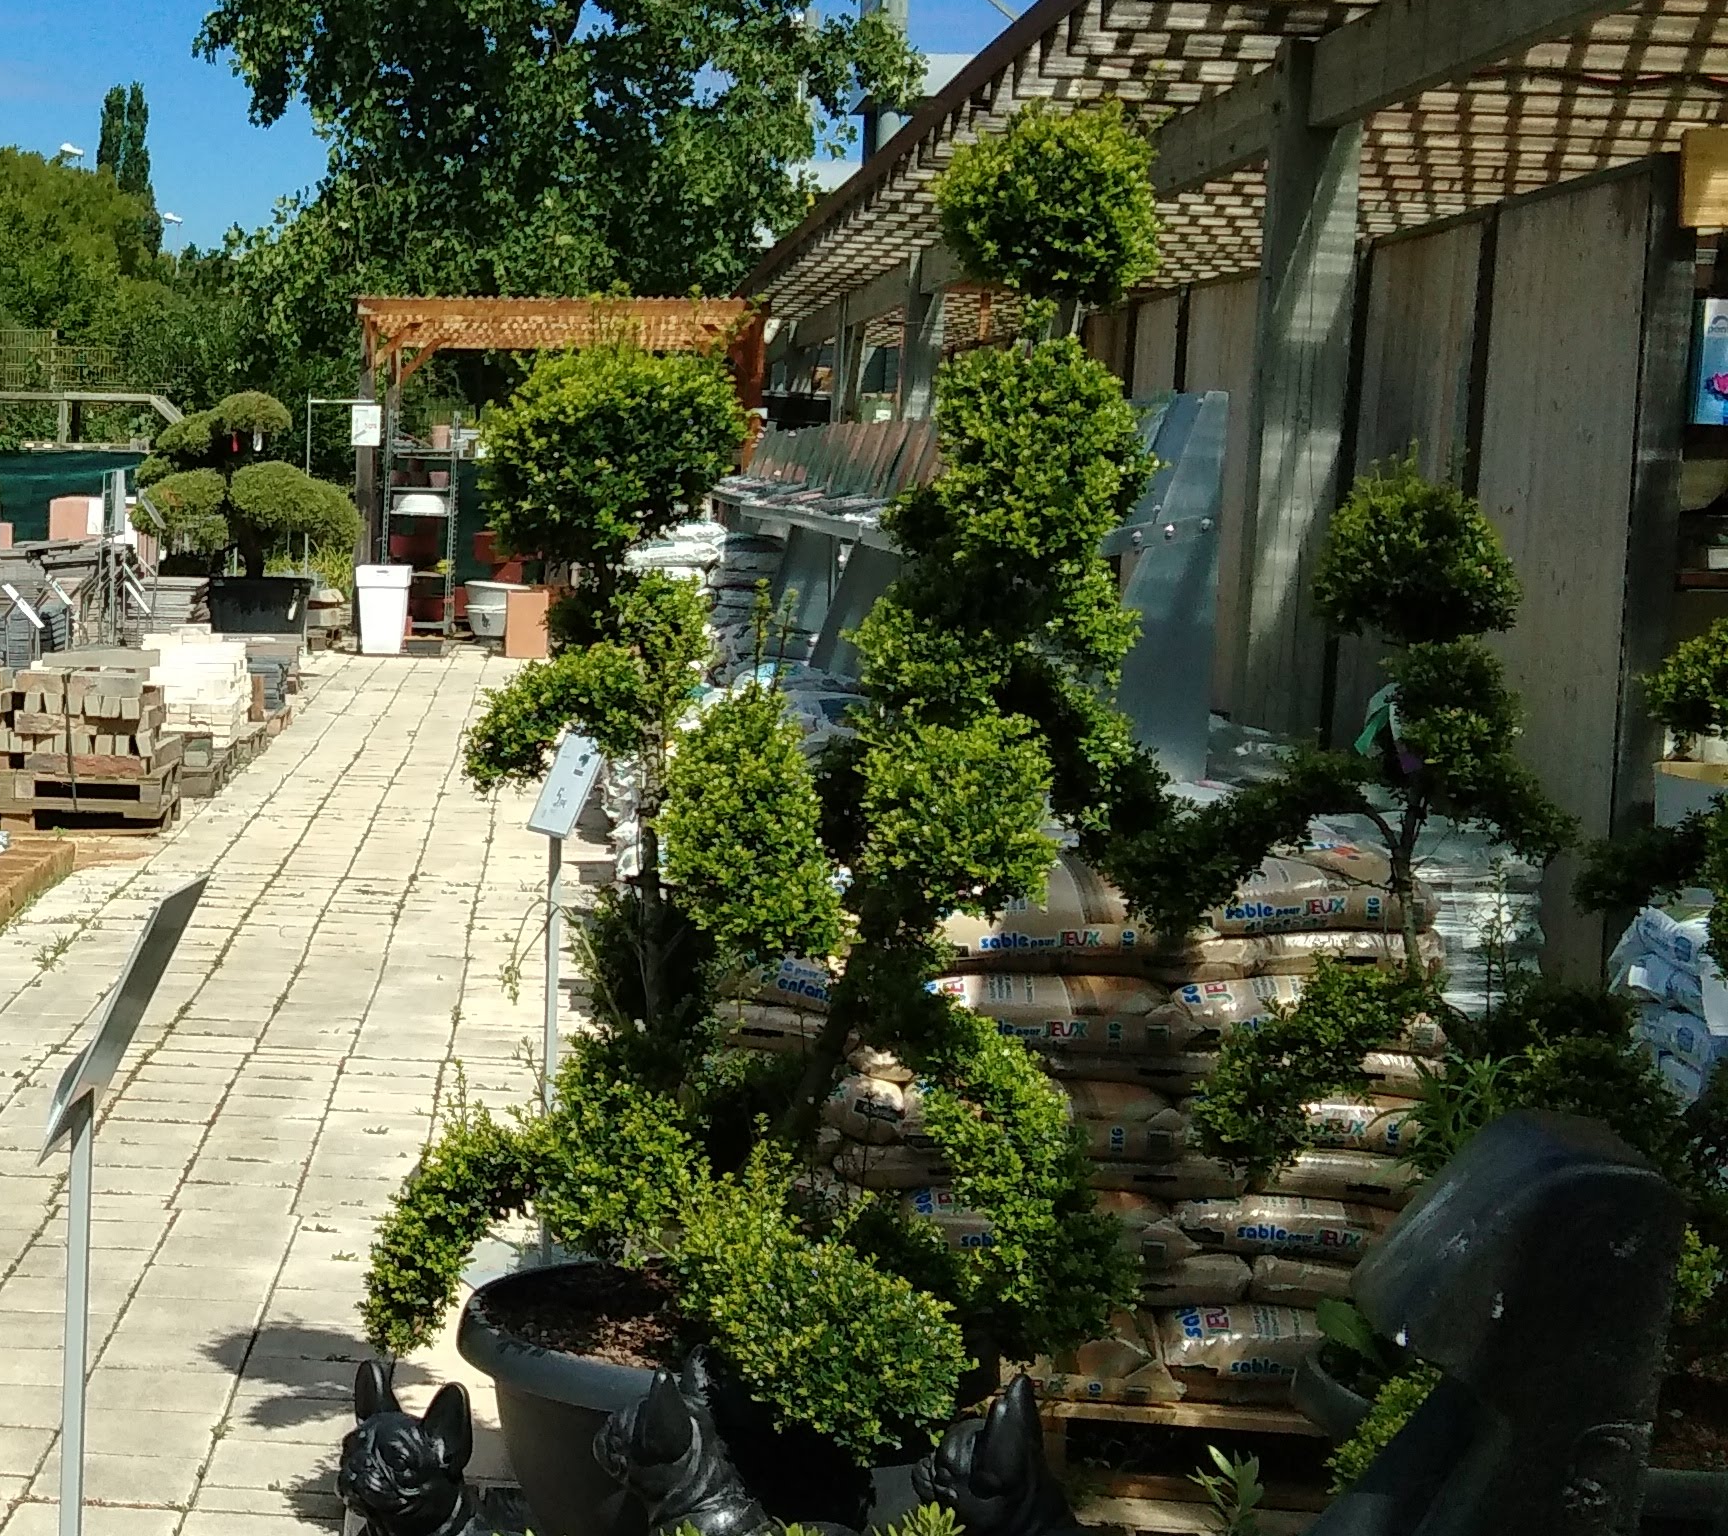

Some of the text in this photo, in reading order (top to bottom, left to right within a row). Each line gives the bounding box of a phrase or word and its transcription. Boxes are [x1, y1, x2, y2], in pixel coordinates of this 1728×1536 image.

[1225, 901, 1274, 920] sable
[1303, 897, 1347, 916] JEUX
[980, 930, 1100, 950] sable pour JEUX
[1042, 1021, 1087, 1038] JEUX
[960, 1232, 993, 1248] sab
[1236, 1224, 1287, 1241] sable
[1314, 1229, 1361, 1248] JEUX
[1230, 1358, 1281, 1373] sable
